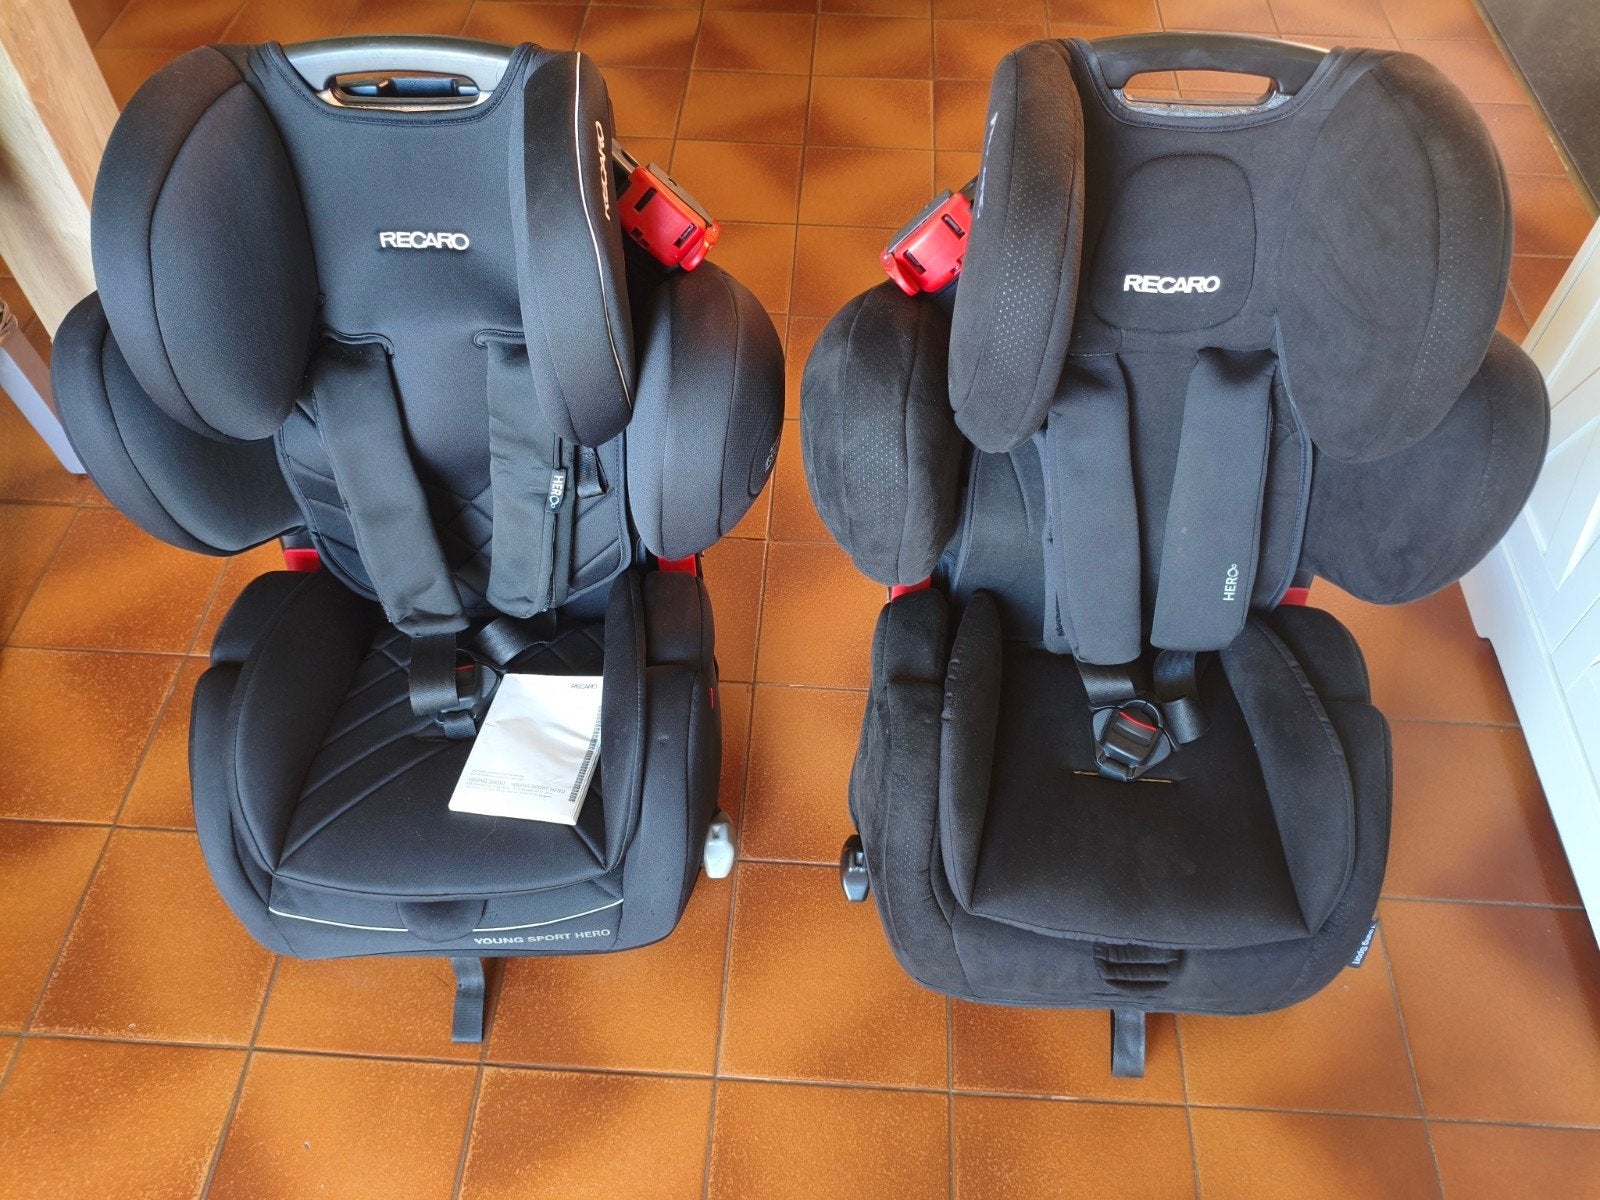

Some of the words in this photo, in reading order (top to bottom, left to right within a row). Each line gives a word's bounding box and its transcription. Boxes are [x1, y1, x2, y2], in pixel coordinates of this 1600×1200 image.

[379, 231, 470, 251] RECARO
[1123, 274, 1221, 294] RECARO
[549, 475, 564, 509] HERO
[1222, 563, 1239, 601] HERO
[473, 937, 524, 945] YOUNG
[527, 932, 572, 943] SPORT
[575, 929, 611, 940] HERO
